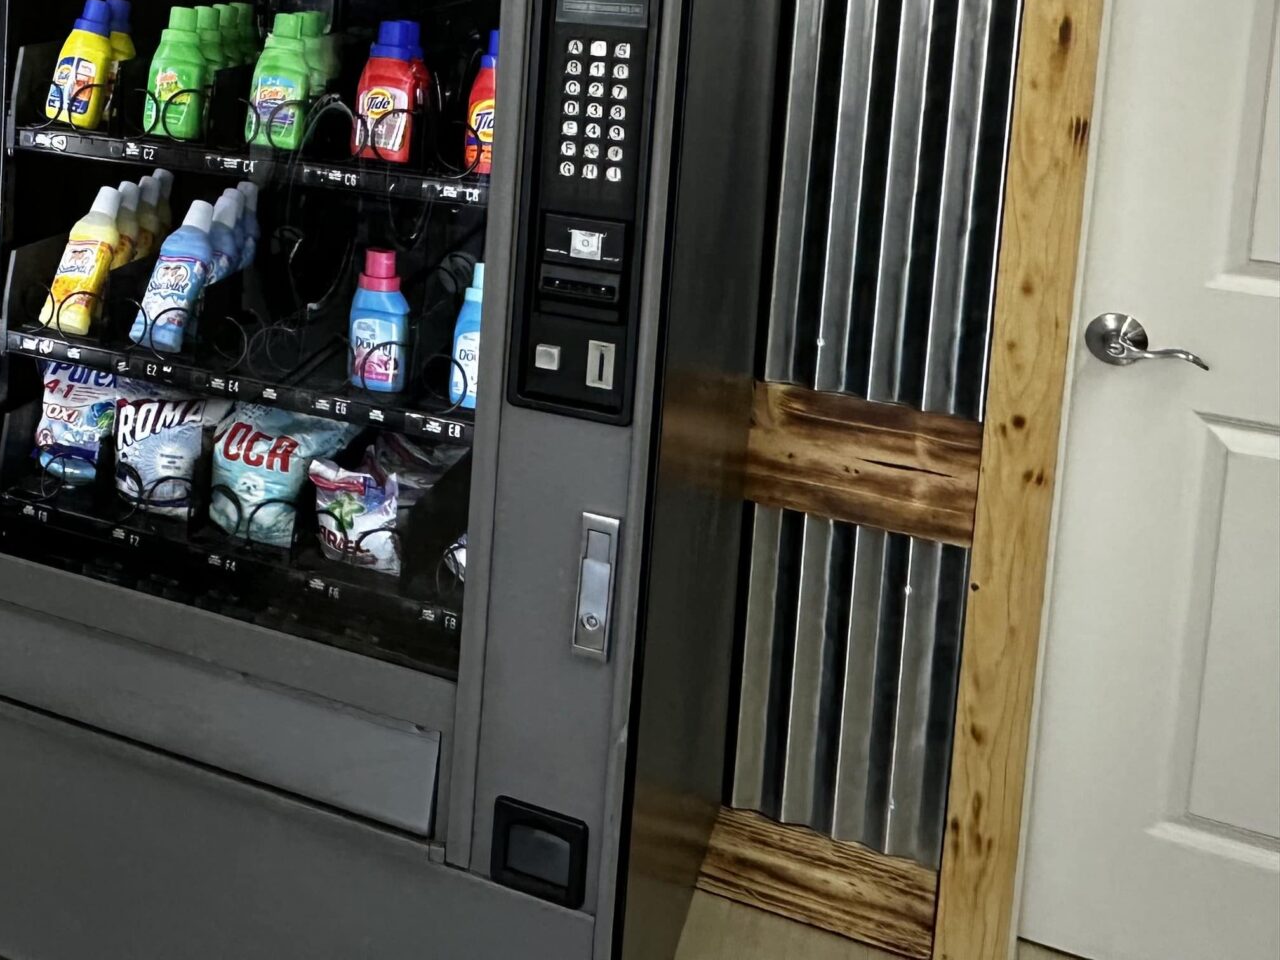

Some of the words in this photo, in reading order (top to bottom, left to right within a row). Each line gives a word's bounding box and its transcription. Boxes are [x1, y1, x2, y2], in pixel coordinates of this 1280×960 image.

[367, 96, 391, 111] Tide
[143, 149, 154, 160] C2
[51, 362, 118, 388] Purex
[146, 364, 157, 376] E2
[46, 404, 79, 422] OXI
[117, 399, 206, 451] ROMA
[214, 421, 299, 472] OCA
